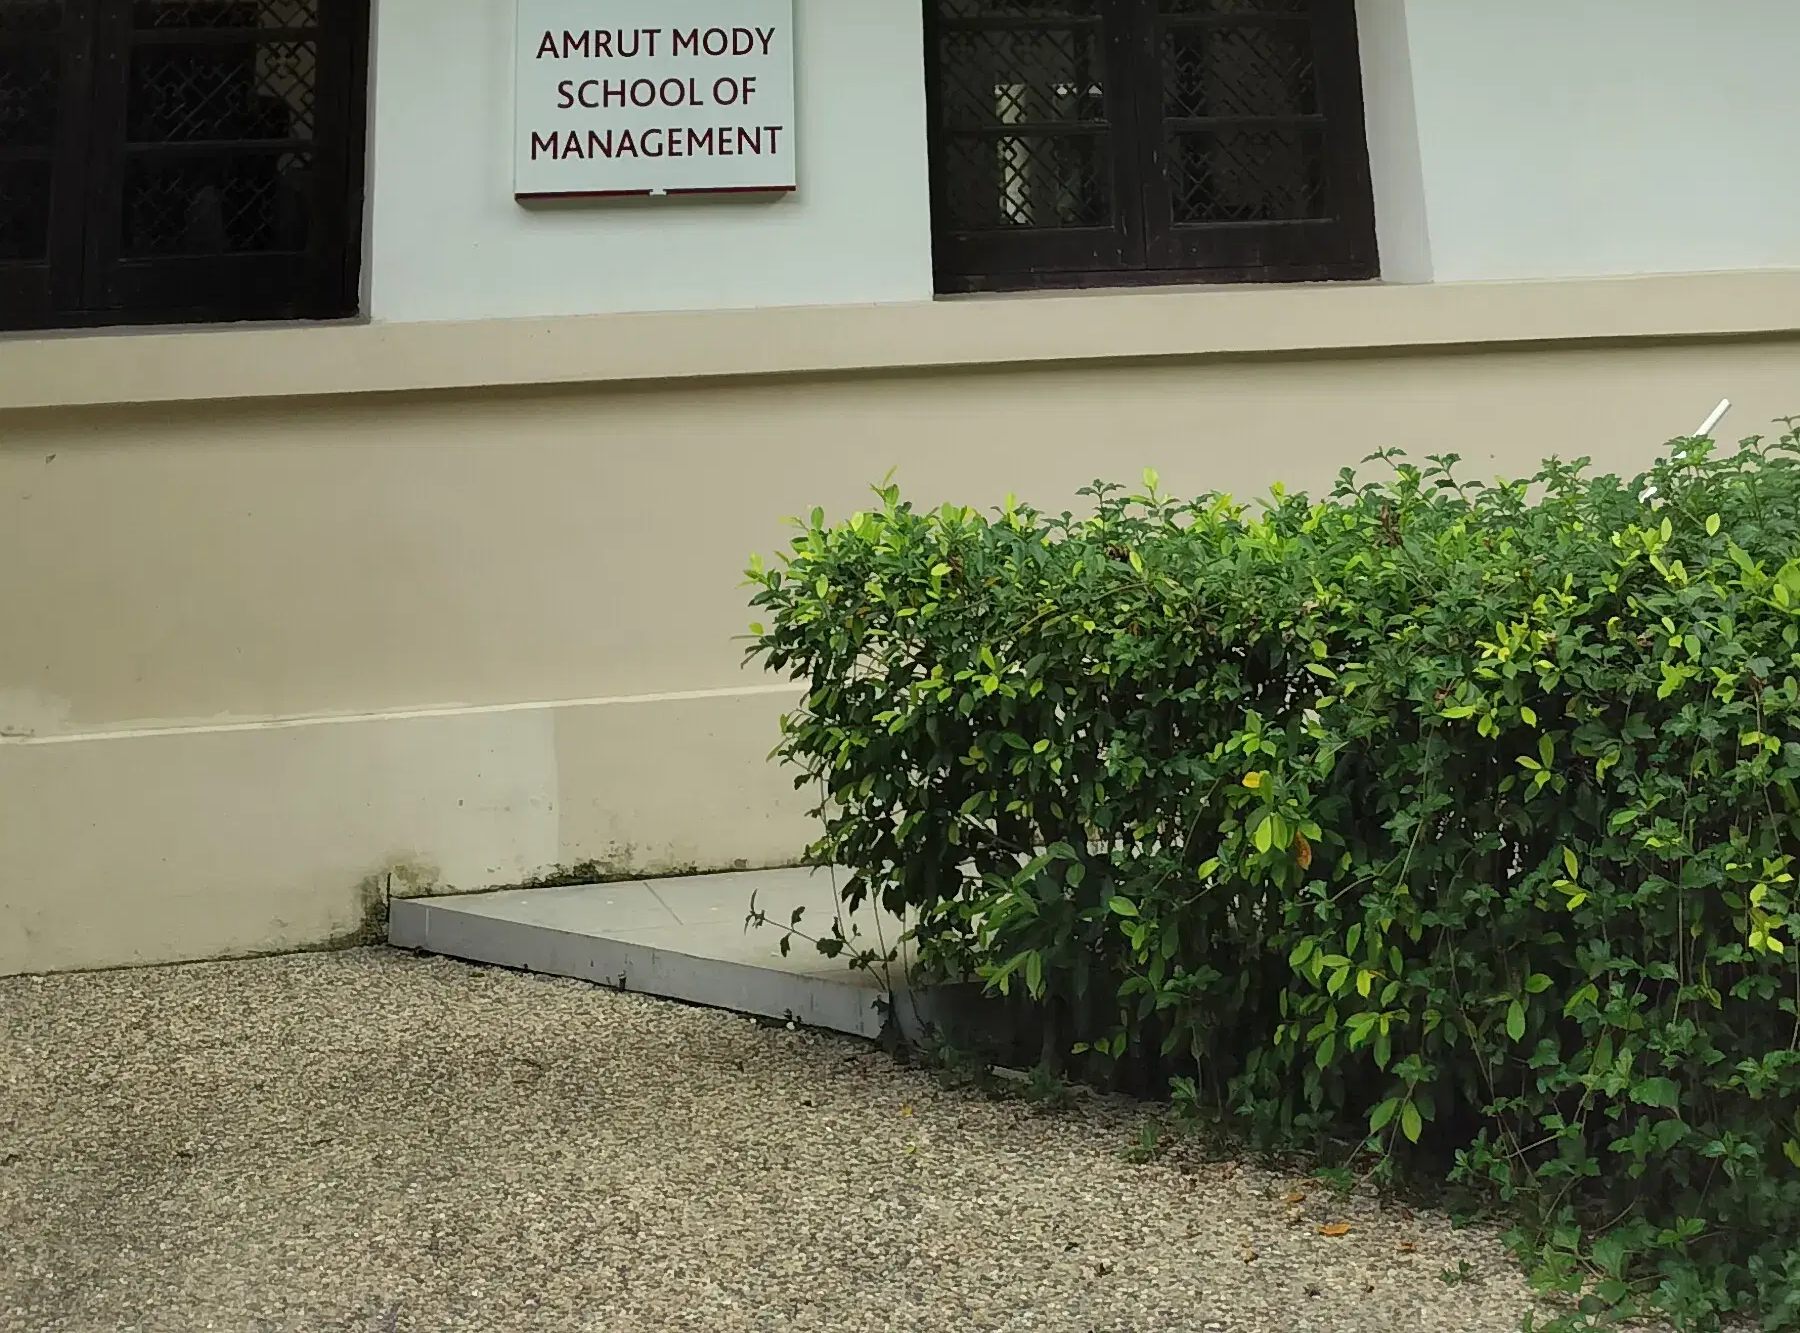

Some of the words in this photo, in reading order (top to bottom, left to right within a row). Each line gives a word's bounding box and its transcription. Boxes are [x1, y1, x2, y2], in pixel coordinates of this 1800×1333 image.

[536, 28, 661, 59] AMRUT
[672, 27, 776, 57] MODY
[556, 77, 704, 109] SCHOOL
[712, 76, 757, 106] OF
[531, 126, 783, 160] MANAGEMENT
